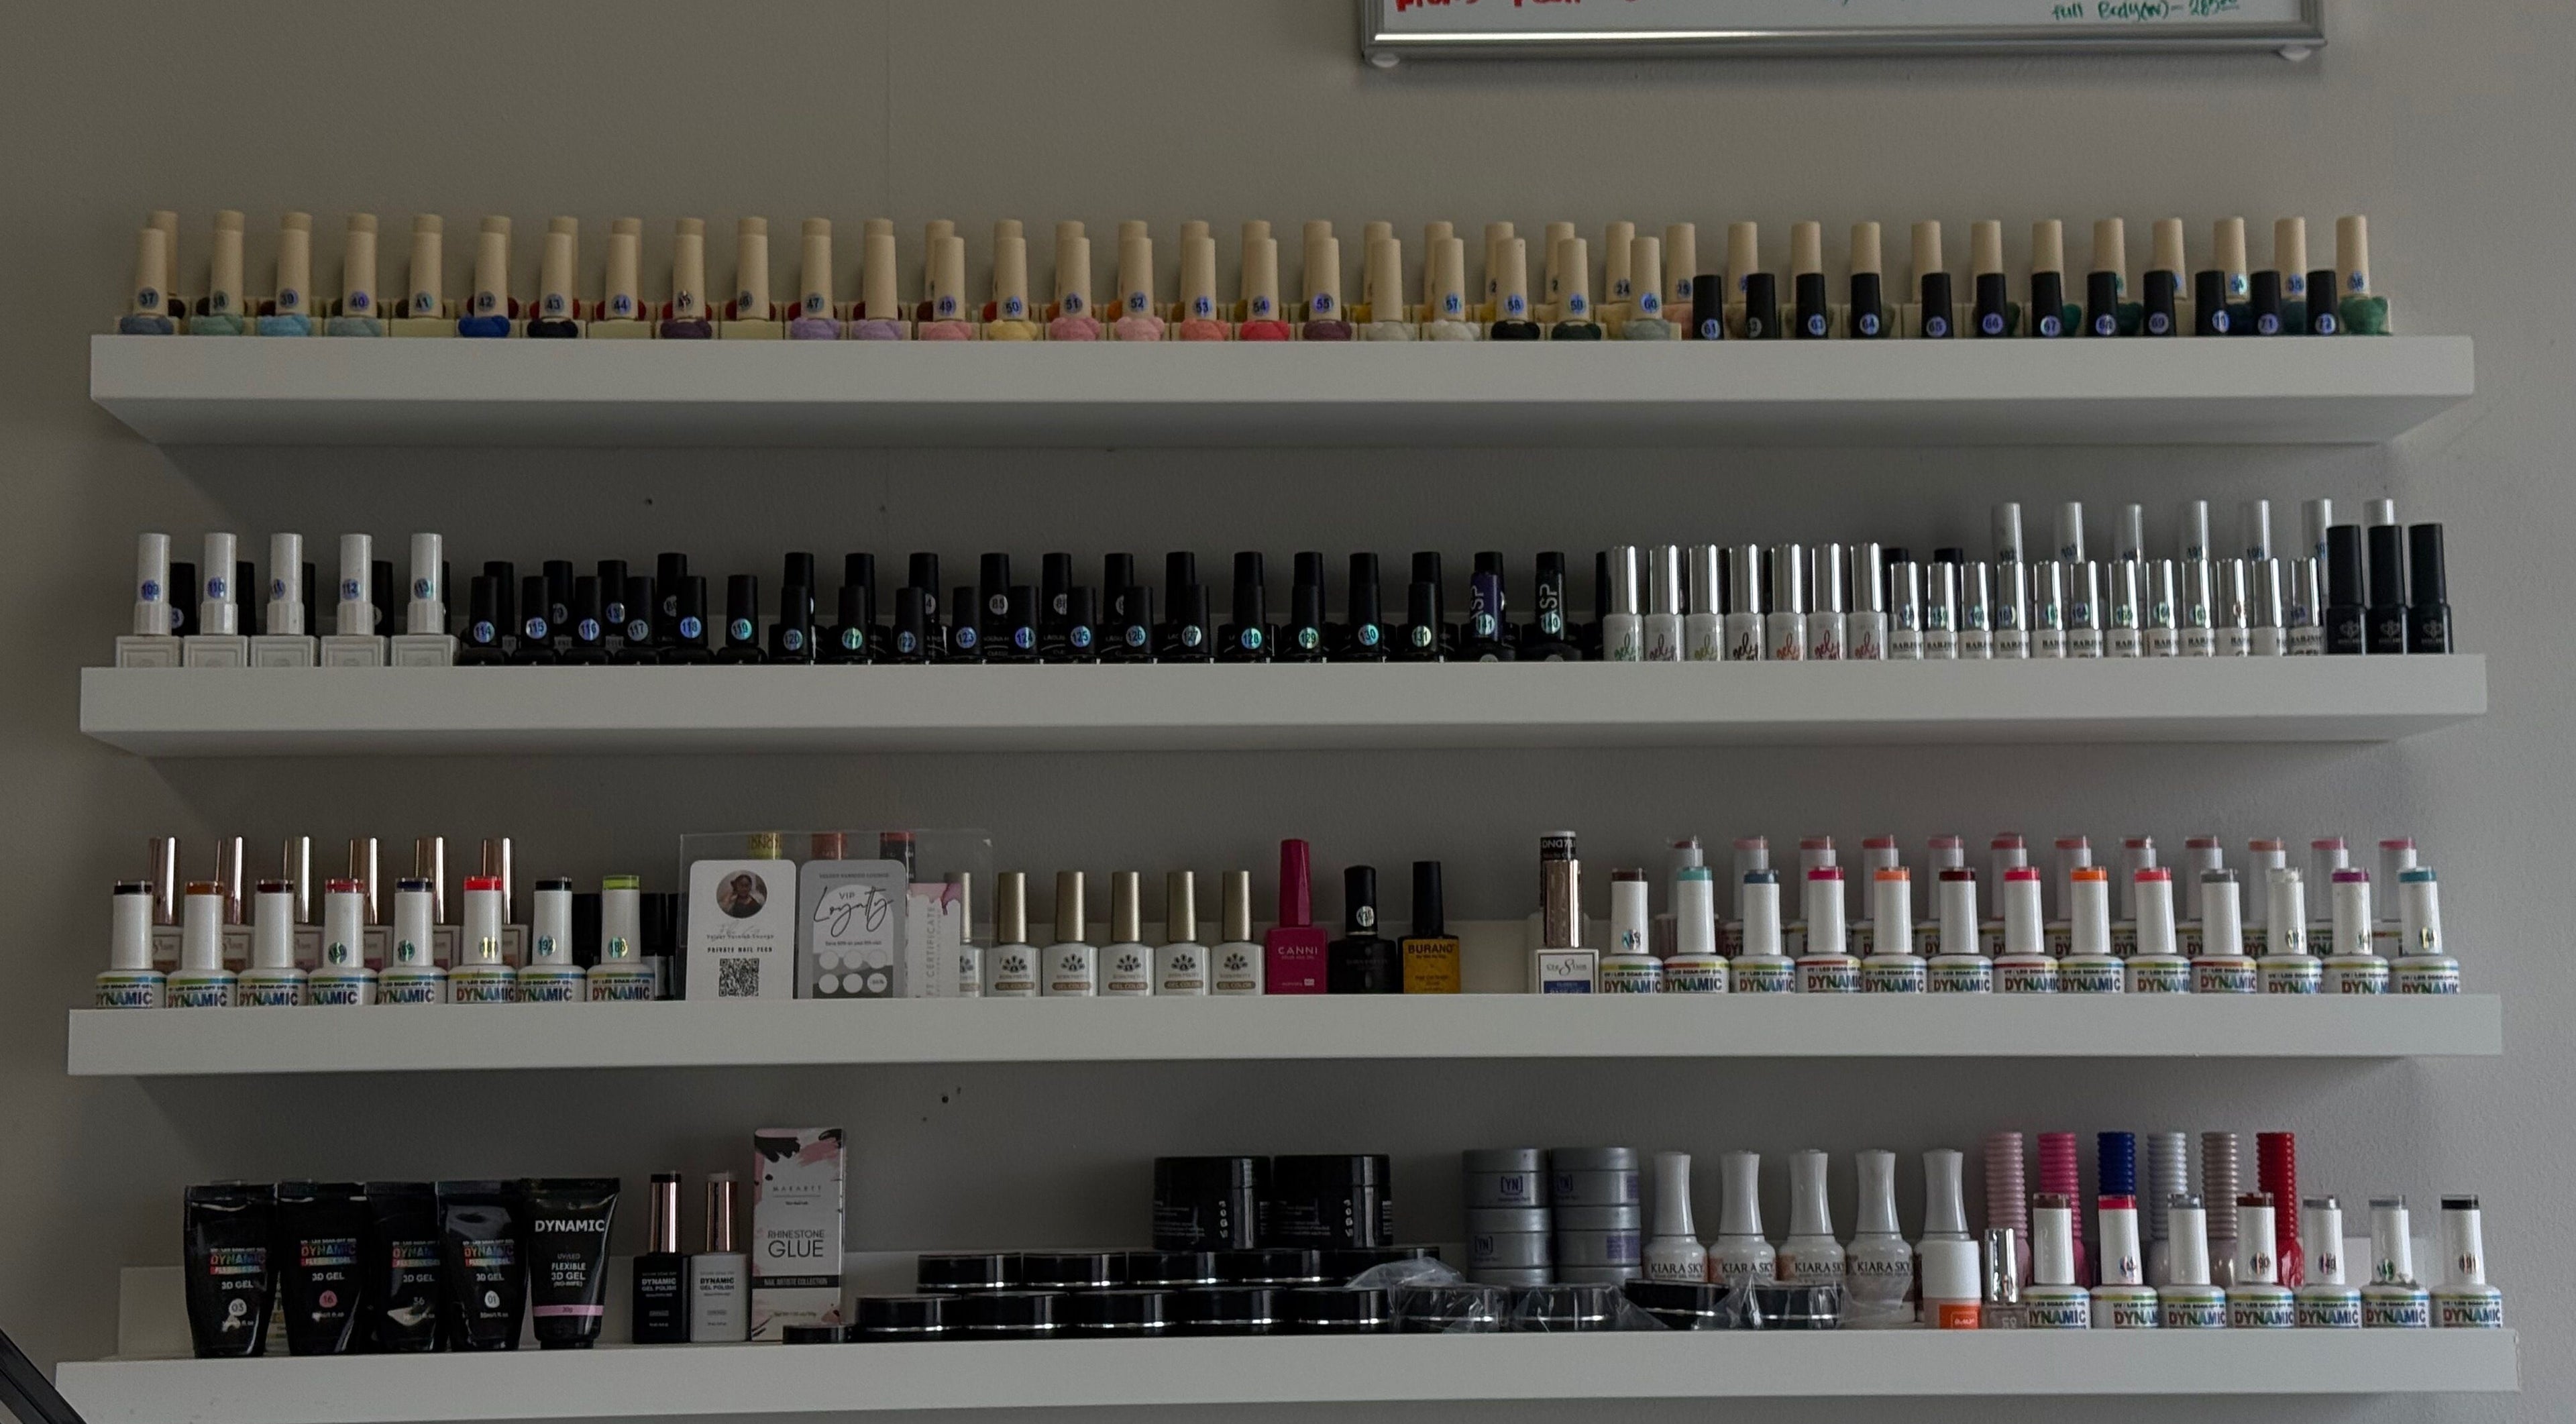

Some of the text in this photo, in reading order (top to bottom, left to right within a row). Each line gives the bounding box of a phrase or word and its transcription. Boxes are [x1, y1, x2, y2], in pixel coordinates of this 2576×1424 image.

[1616, 282, 1629, 294] 24
[140, 294, 154, 305] 37
[351, 296, 364, 308] 40
[478, 296, 491, 307] 42
[547, 298, 560, 309] 43
[614, 298, 627, 310] 44
[807, 296, 820, 308] 47
[1065, 299, 1078, 310] 51
[1130, 298, 1144, 309] 52
[1253, 300, 1266, 311] 54
[1316, 298, 1330, 309] 55
[1446, 298, 1458, 309] 57
[939, 300, 952, 312] 49
[1196, 300, 1209, 312] 53
[529, 622, 544, 633] 115
[582, 623, 597, 634] 116
[630, 622, 644, 636] 117
[959, 632, 974, 643] 123
[1016, 632, 1032, 643] 124
[1073, 631, 1088, 642] 125
[1128, 631, 1143, 641] 126
[1243, 634, 1258, 645] 128
[1301, 632, 1316, 643] 129
[1360, 628, 1376, 642] 130
[1414, 631, 1428, 641] 131
[813, 885, 894, 938] Loyalty
[926, 906, 935, 979] CERTIFICATE
[1408, 943, 1454, 954] BURANO
[1278, 946, 1318, 955] CANNI
[1604, 979, 1661, 993] DYNAMIC
[1664, 978, 1722, 991] DYNAMIC
[1739, 979, 1794, 993] DYNAMIC
[1865, 979, 1924, 992] DYNAMIC
[1933, 979, 1990, 992] DYNAMIC
[2004, 978, 2059, 991] DYNAMIC
[2062, 978, 2121, 991] DYNAMIC
[2200, 975, 2256, 988] DYNAMIC
[2342, 981, 2390, 993] DYNAM
[457, 987, 514, 1001] DYNAMIC
[592, 987, 651, 1000] DYNAMIC
[2402, 982, 2459, 994] DYNAMIC
[168, 992, 227, 1007] DYNAMIC
[239, 992, 298, 1006] DYNAMIC
[535, 1219, 605, 1233] DYNAMIC
[768, 1229, 825, 1239] RHINESTONE
[301, 1244, 356, 1256] DYNAMIC
[768, 1240, 824, 1258] GLUE
[211, 1253, 266, 1266] DYNAMIC
[551, 1262, 586, 1270] FLEXIBLE
[1651, 1263, 1704, 1274] KIARA SKY
[1722, 1262, 1774, 1274] KIARA SKY
[1794, 1262, 1830, 1273] KIARA
[1858, 1262, 1910, 1272] KIARA SKY
[328, 1272, 345, 1281] GEL
[416, 1274, 435, 1282] GEL
[488, 1272, 504, 1281] GEL
[551, 1272, 586, 1280] 3D GEL
[236, 1279, 254, 1289] GEL
[231, 1303, 244, 1313] 03
[2168, 1311, 2226, 1325] DYNAMIC
[2235, 1309, 2294, 1324] DYNAMIC
[2299, 1309, 2359, 1324] DYNAMIC
[2367, 1309, 2426, 1324] DYNAMIC
[2443, 1309, 2501, 1322] DYNAMIC
